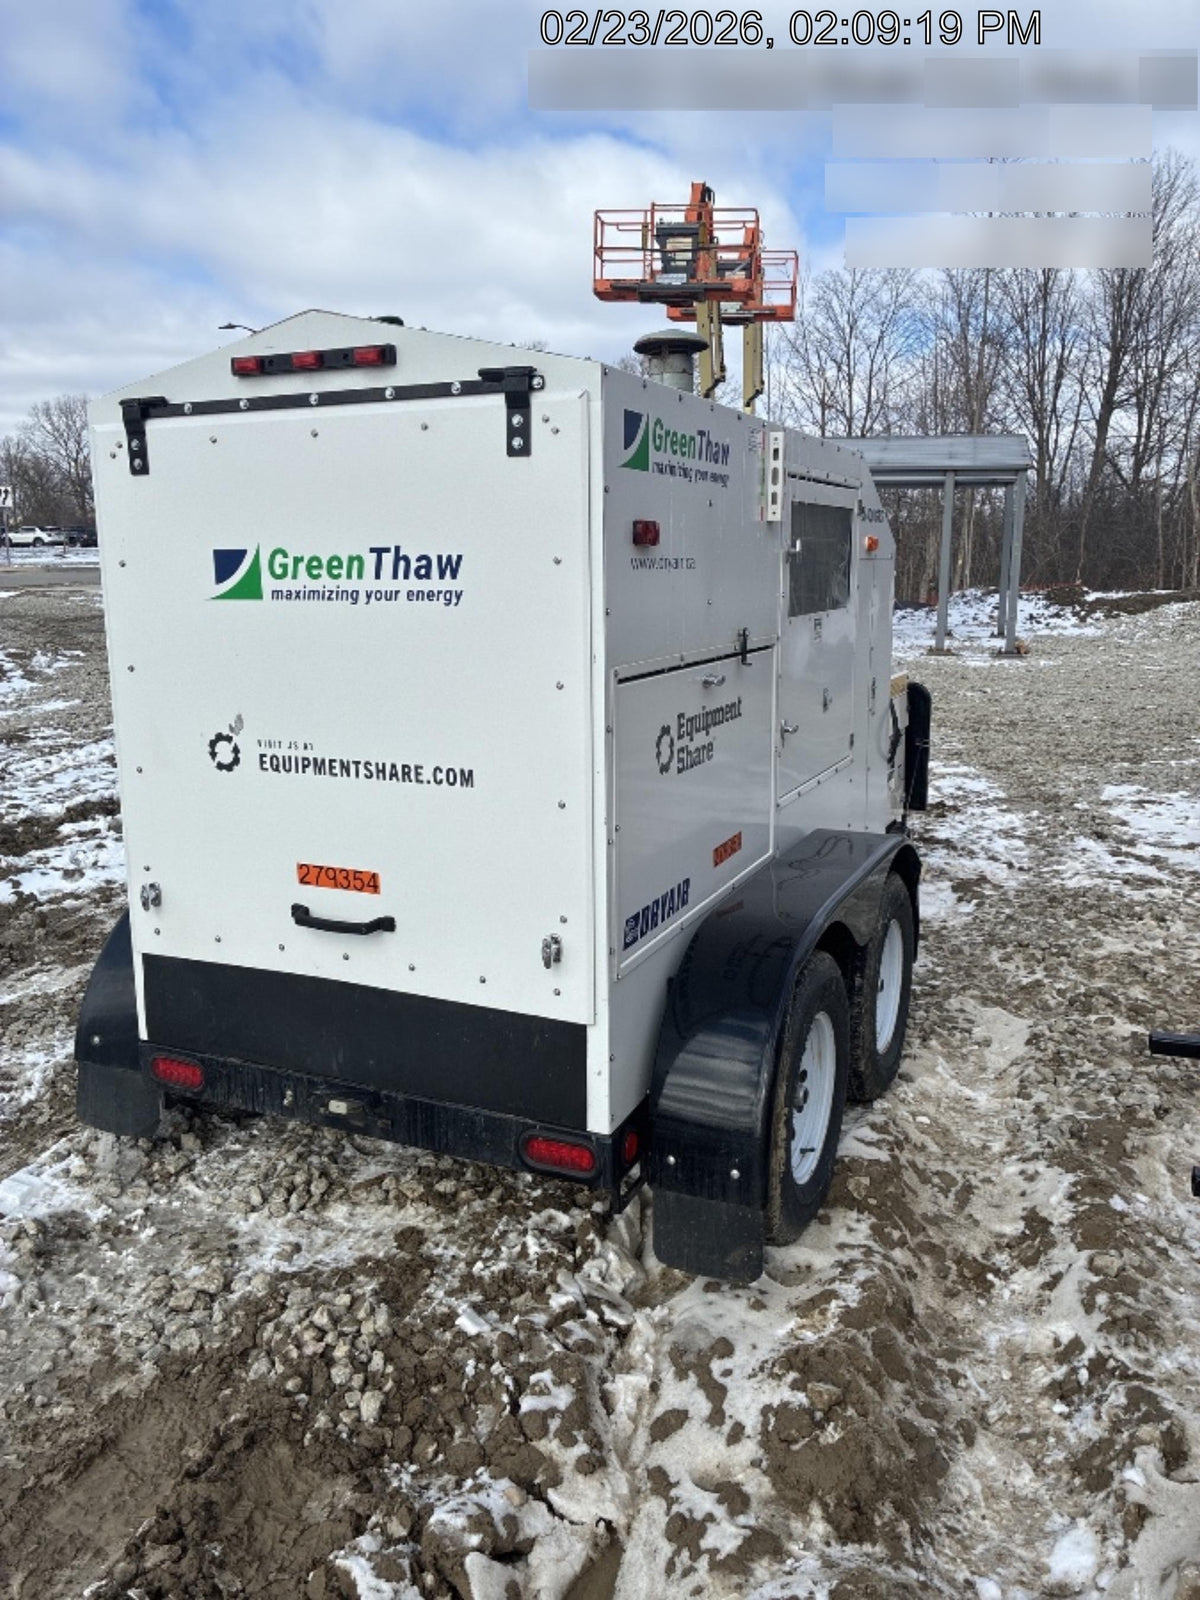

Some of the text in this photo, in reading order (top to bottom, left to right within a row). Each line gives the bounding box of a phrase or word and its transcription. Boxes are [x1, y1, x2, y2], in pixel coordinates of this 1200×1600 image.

[652, 417, 730, 466] GreenThaw
[267, 545, 464, 581] GreenThaw
[271, 585, 464, 606] maximizing your energy
[676, 696, 743, 742] Equipment
[257, 739, 282, 750] VISIT
[676, 740, 714, 774] Share
[258, 753, 475, 788] EQUIPMENTSHARE.COM
[298, 864, 380, 893] 279354
[639, 877, 691, 940] DRYAIR
